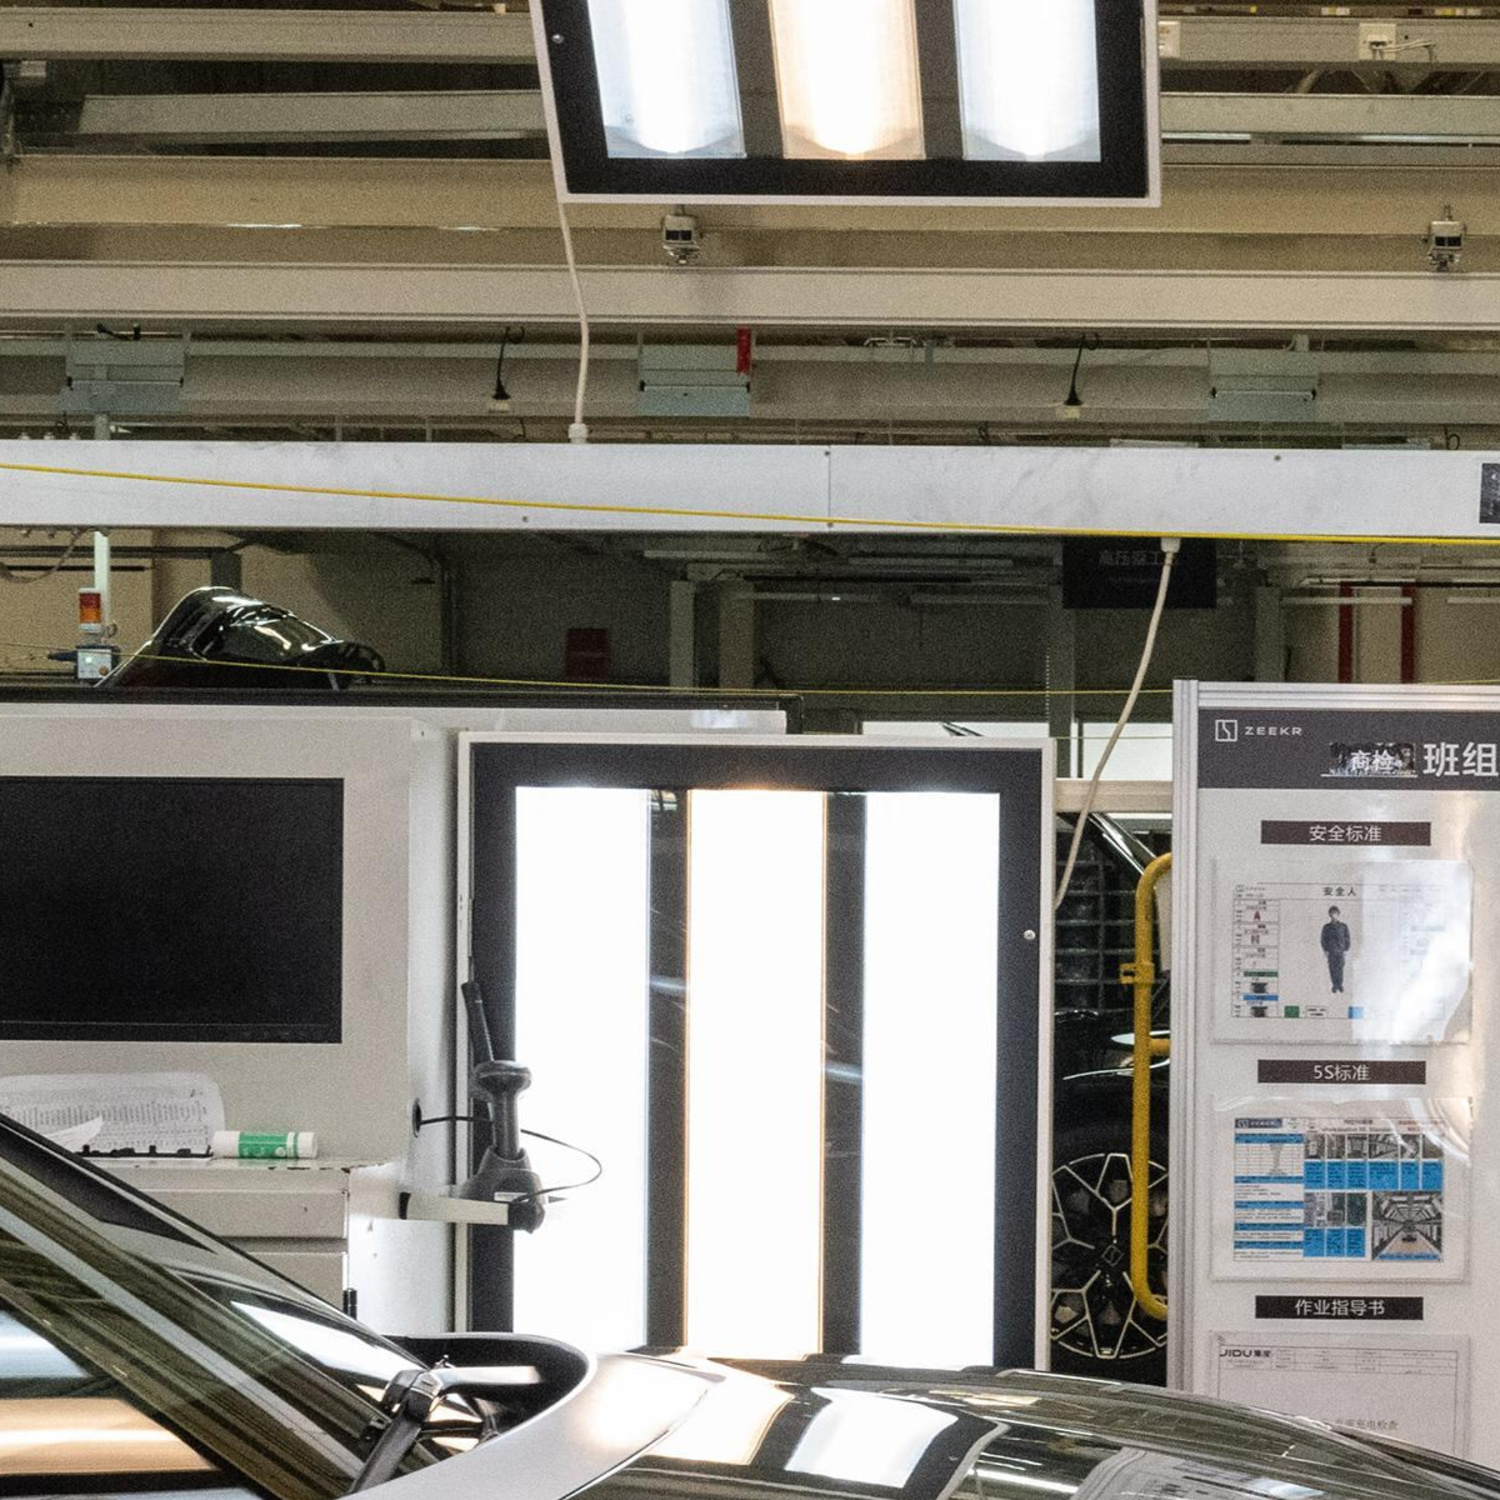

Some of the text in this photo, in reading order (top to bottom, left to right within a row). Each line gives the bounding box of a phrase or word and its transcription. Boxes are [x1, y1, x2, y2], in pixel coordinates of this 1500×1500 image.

[1244, 726, 1302, 736] ZEEKR
[1422, 742, 1499, 777] 班组
[1308, 825, 1382, 842] 安全标准
[1313, 1064, 1370, 1081] 5S标准
[1294, 1299, 1386, 1317] 作业指导书
